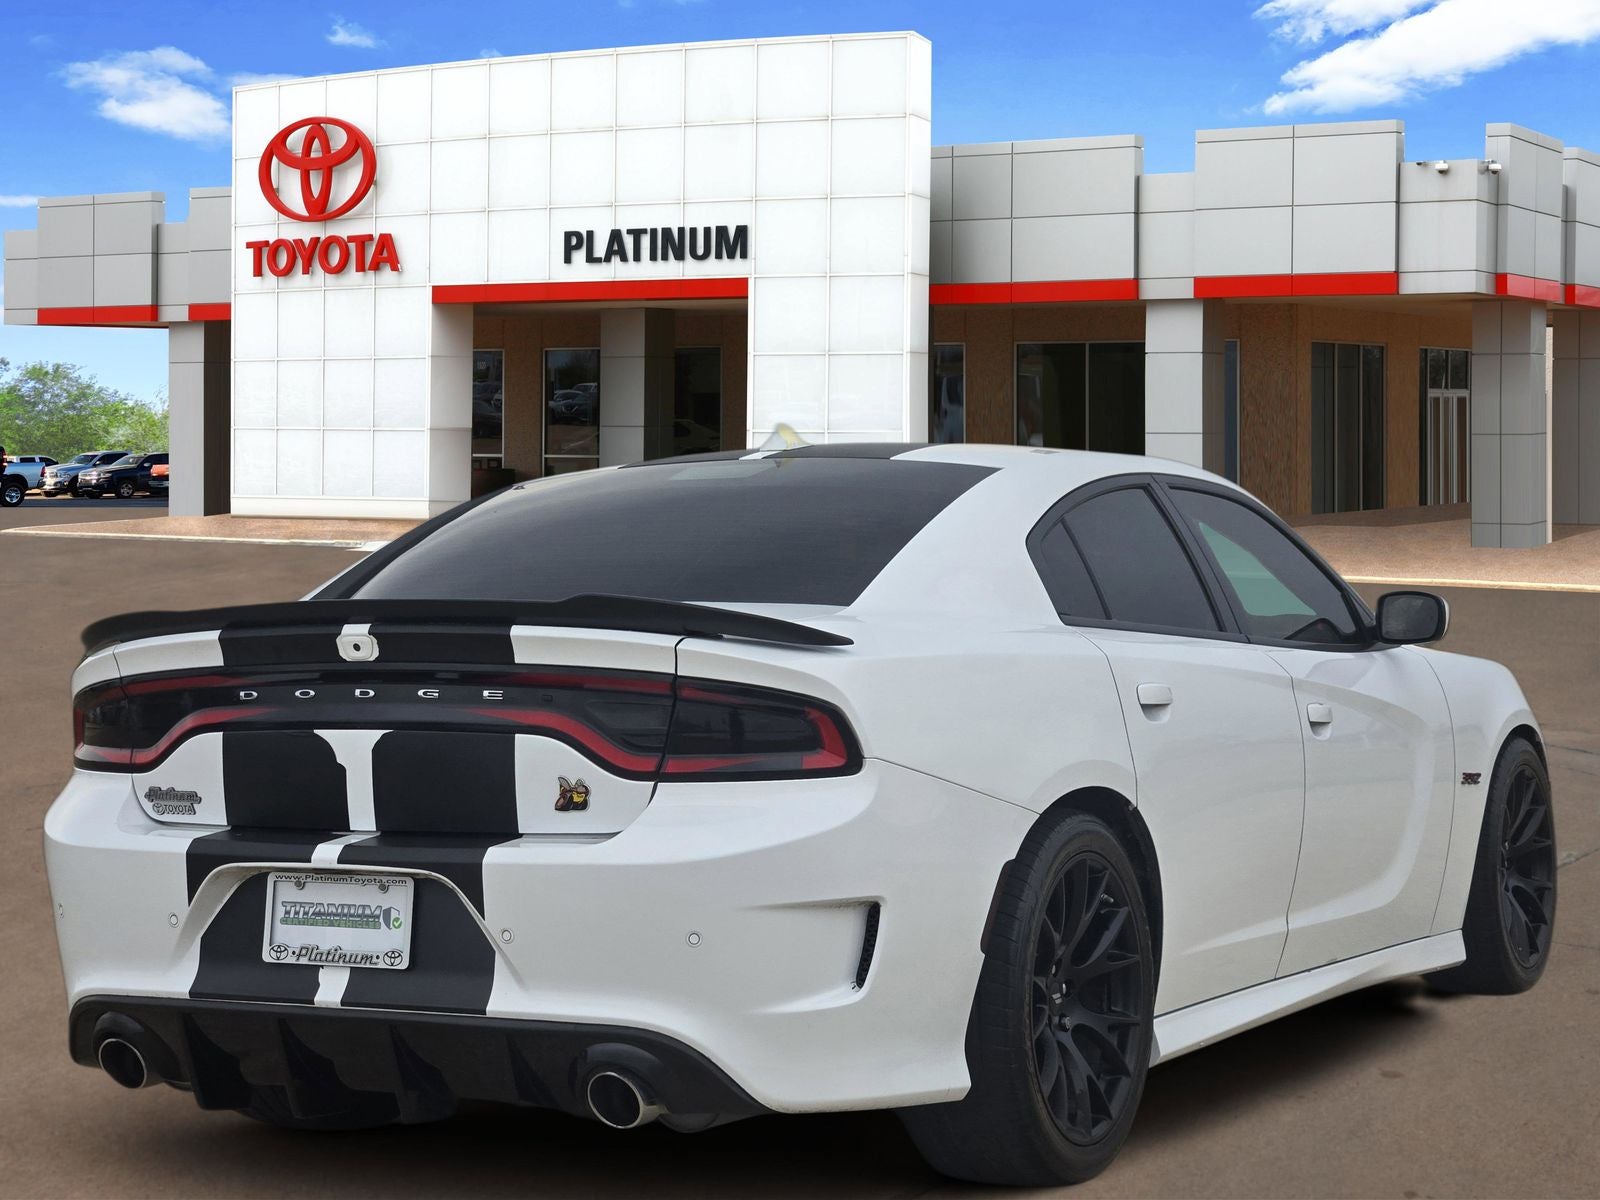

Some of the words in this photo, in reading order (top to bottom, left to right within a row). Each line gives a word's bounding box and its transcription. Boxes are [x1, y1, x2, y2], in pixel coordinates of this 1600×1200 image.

[564, 225, 748, 264] PLATINUM
[246, 233, 401, 277] TOYOTA
[239, 688, 504, 701] DODGE
[144, 786, 201, 803] Platinum
[163, 804, 195, 815] TOYOTA
[274, 874, 407, 885] www.PlatinumToyota.com
[281, 900, 383, 921] TITANIUM
[280, 917, 330, 927] CERTIFIED
[333, 918, 381, 929] VEHICLES
[295, 944, 380, 966] Platinum
